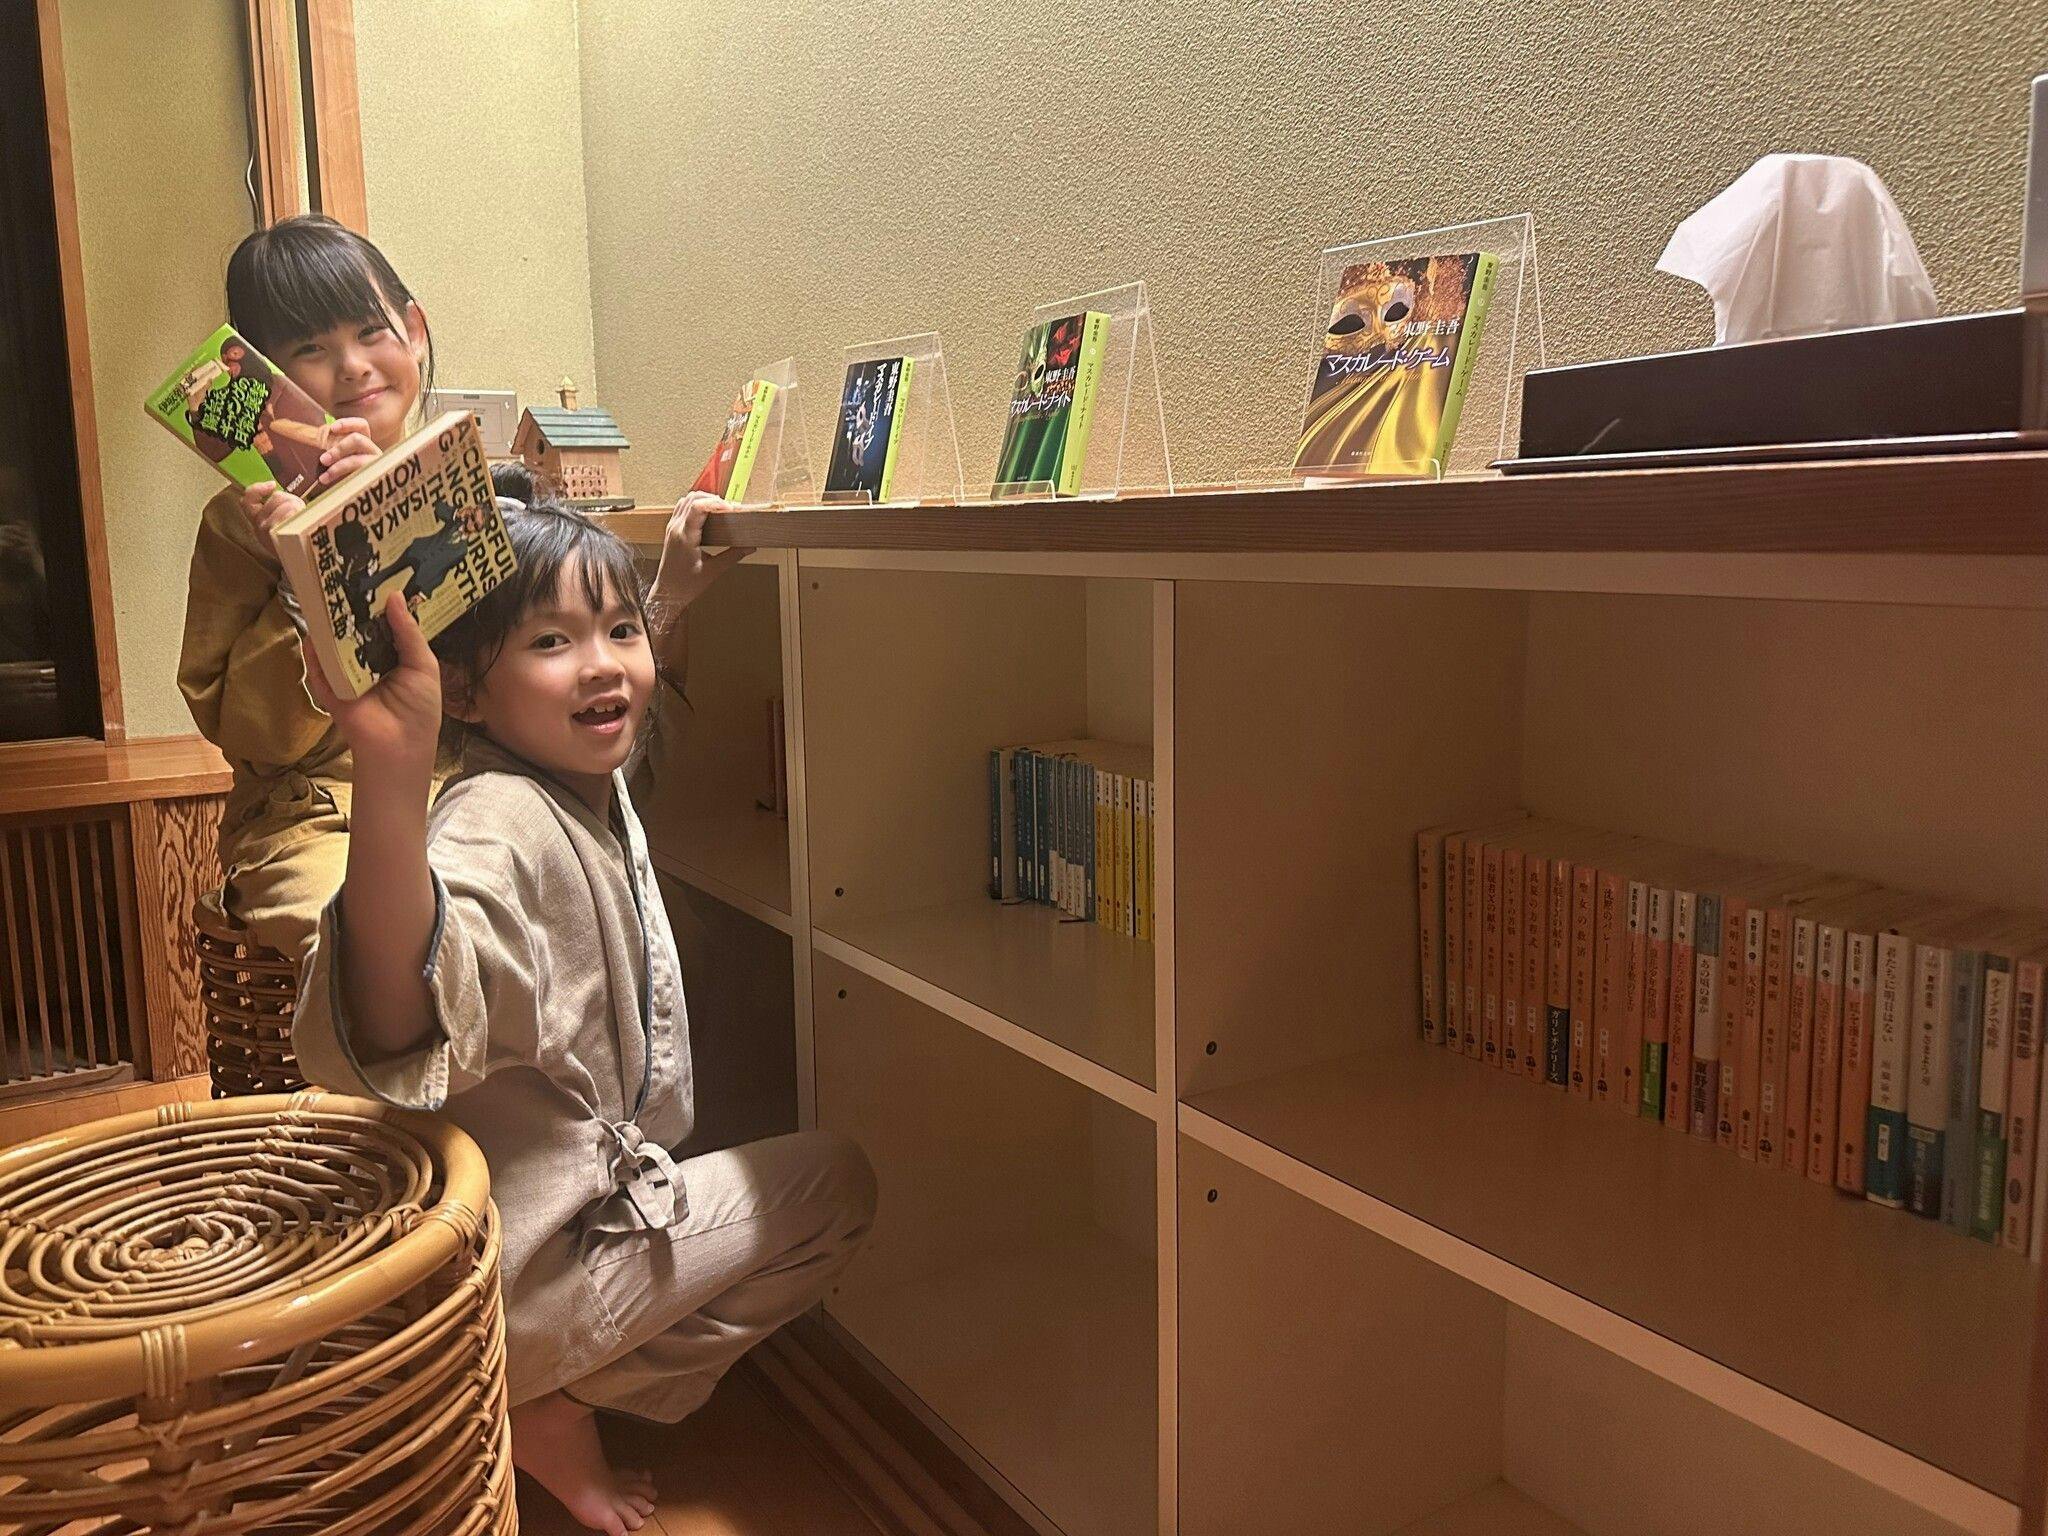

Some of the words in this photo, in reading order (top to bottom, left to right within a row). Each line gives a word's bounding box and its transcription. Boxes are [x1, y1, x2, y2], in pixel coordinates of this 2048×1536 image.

[1404, 318, 1460, 337] 東野圭吾
[1325, 347, 1450, 378] マスカレード・ゲーム
[455, 420, 471, 444] A
[342, 453, 421, 522] KOTARO
[371, 485, 426, 541] ISAKA
[310, 525, 349, 640] 伊坂幸太郎
